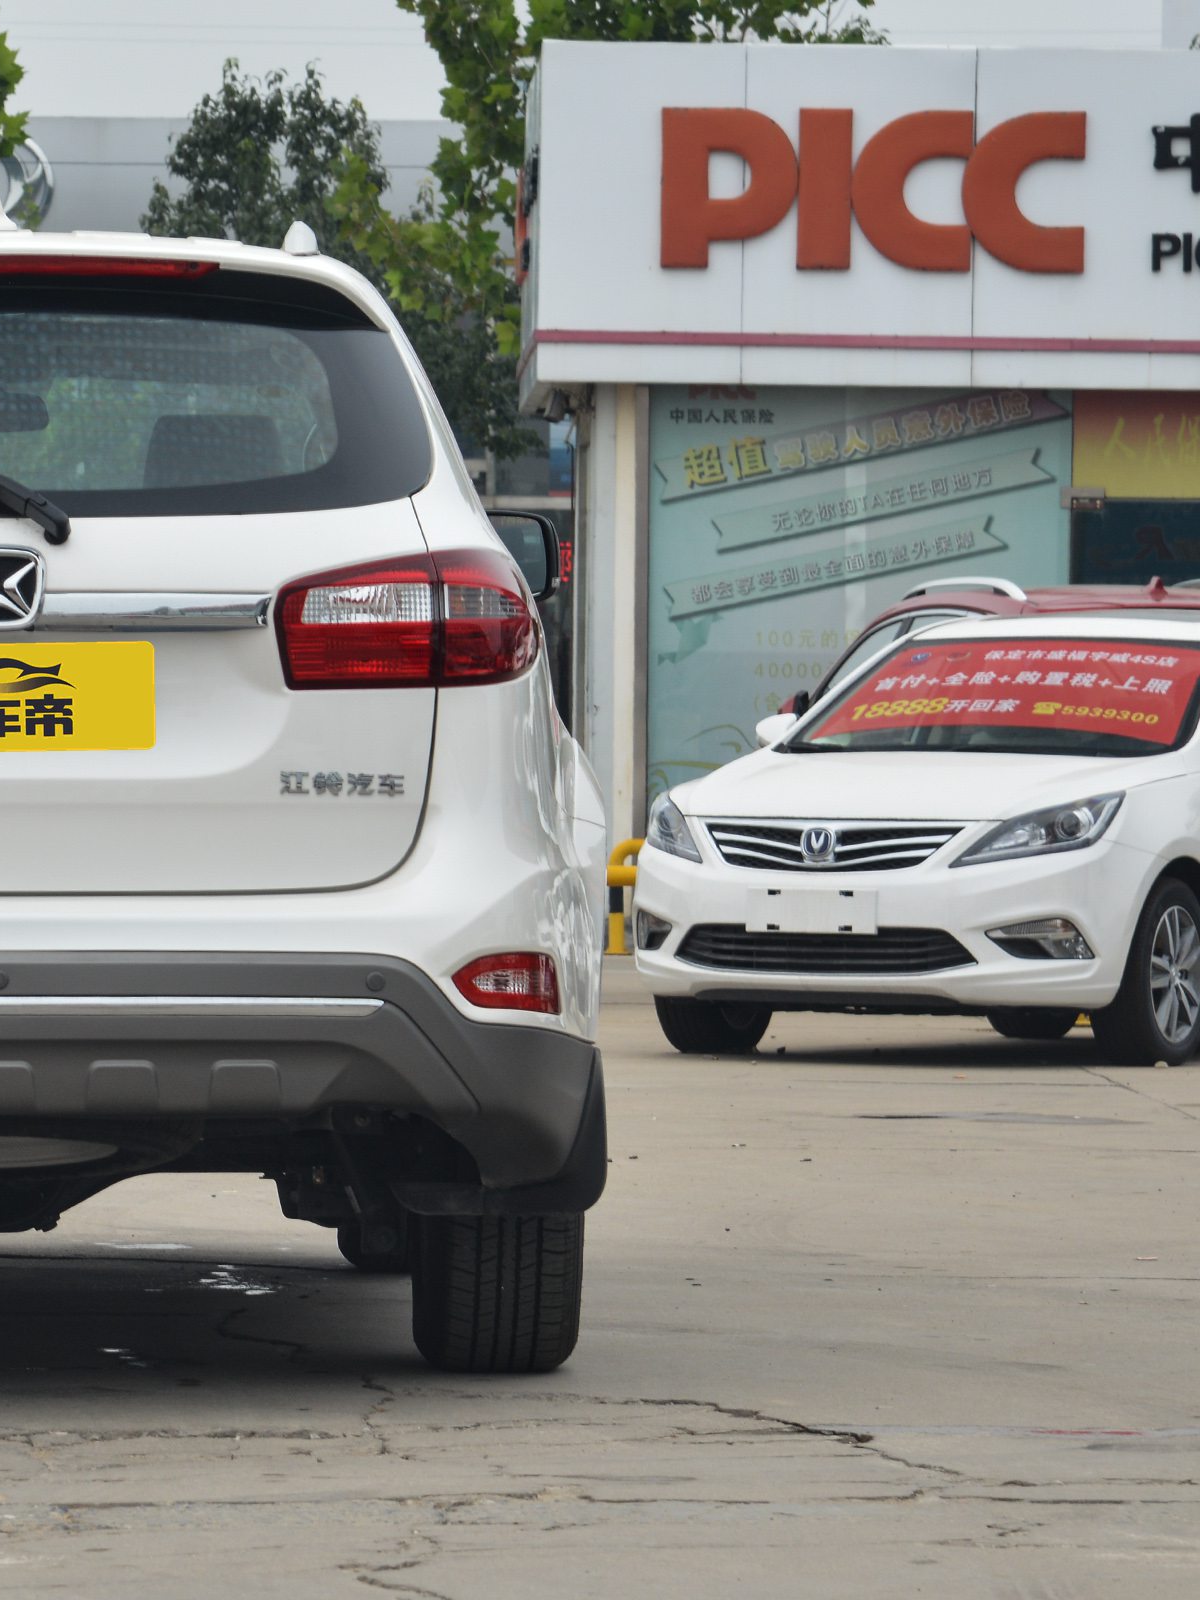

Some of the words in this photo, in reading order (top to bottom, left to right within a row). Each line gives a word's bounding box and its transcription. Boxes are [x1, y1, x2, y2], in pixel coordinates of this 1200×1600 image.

[660, 108, 1086, 273] PICC
[1152, 232, 1200, 273] PI
[670, 407, 775, 425] 中国人民保险
[280, 771, 405, 797] 江铃汽车
